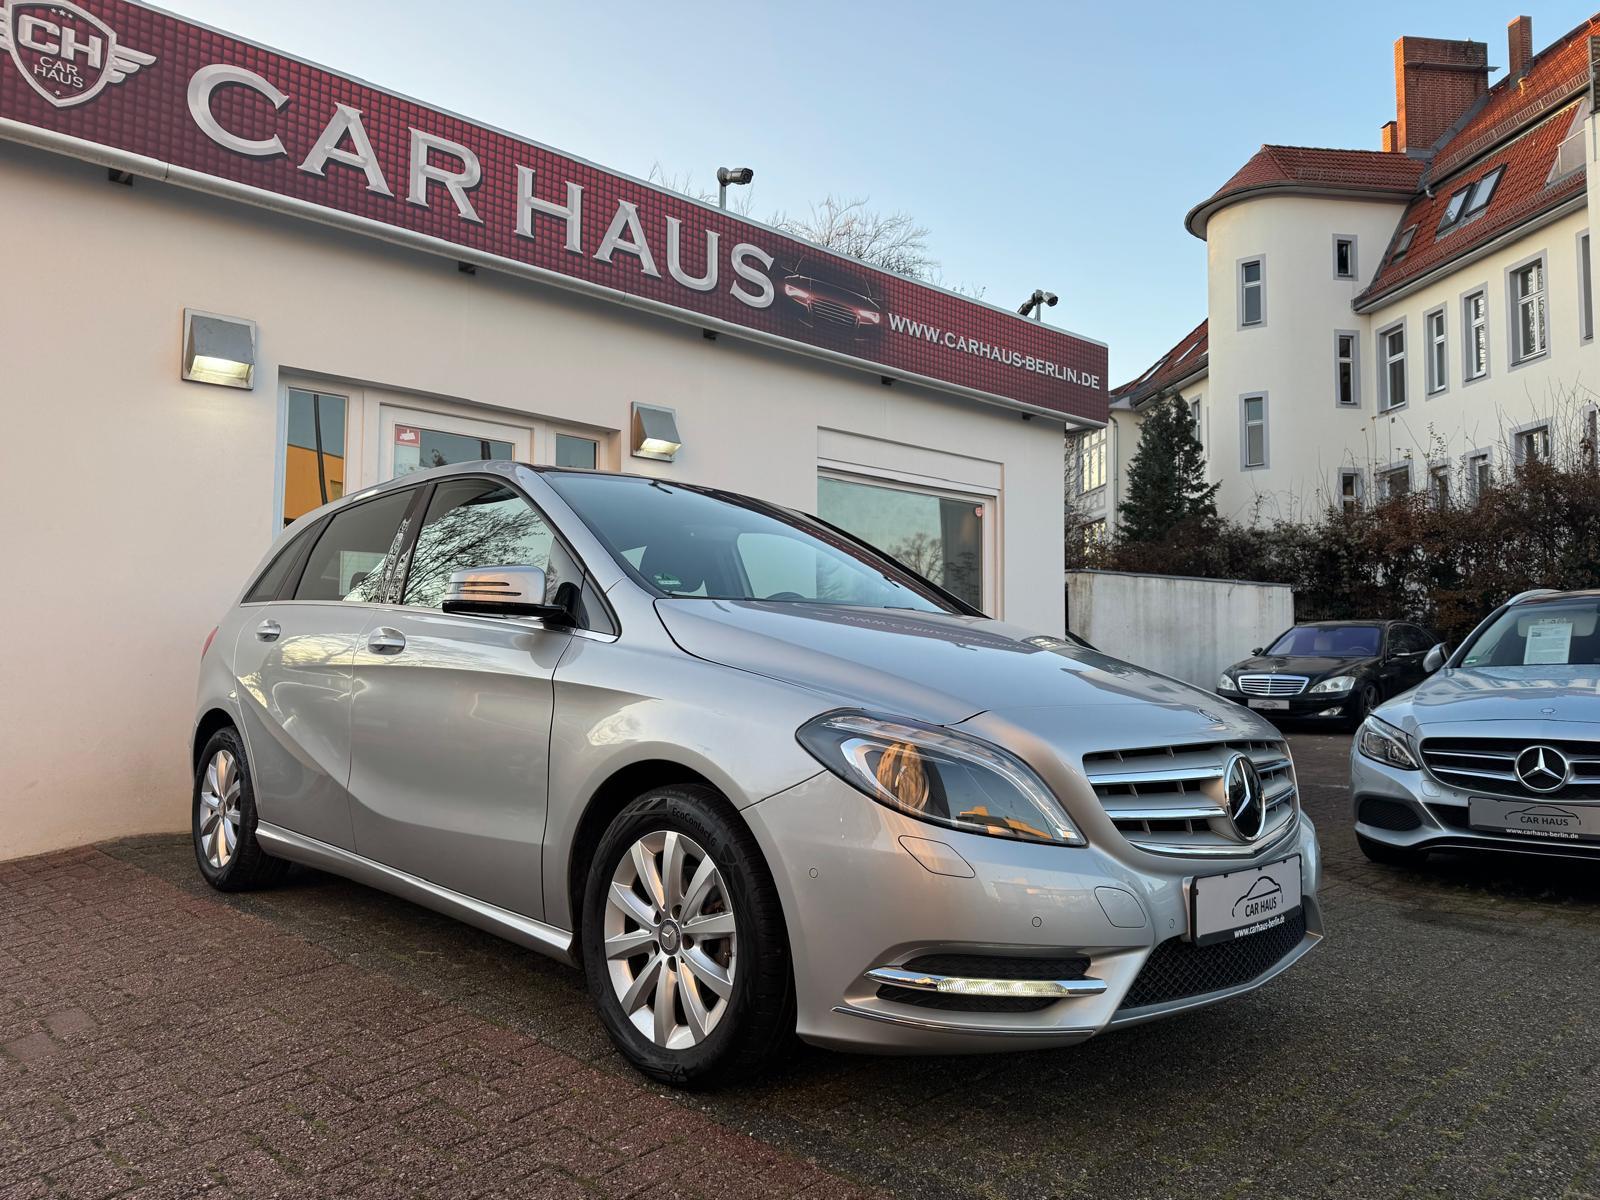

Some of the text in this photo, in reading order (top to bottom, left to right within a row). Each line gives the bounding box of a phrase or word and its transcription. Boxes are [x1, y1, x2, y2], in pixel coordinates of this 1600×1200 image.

[18, 14, 102, 69] CH
[34, 64, 84, 88] HAUS
[39, 56, 78, 76] CAR
[187, 64, 775, 308] CAR HAUS
[888, 312, 1100, 390] WWW.CARHAUS-BERLIN.DE
[1520, 816, 1569, 826] CAR HAUS
[1505, 828, 1579, 839] www.carhaus-berlin.de
[1244, 897, 1277, 917] CAR HAUS
[1234, 915, 1286, 939] www.carhaus-berlin.de
